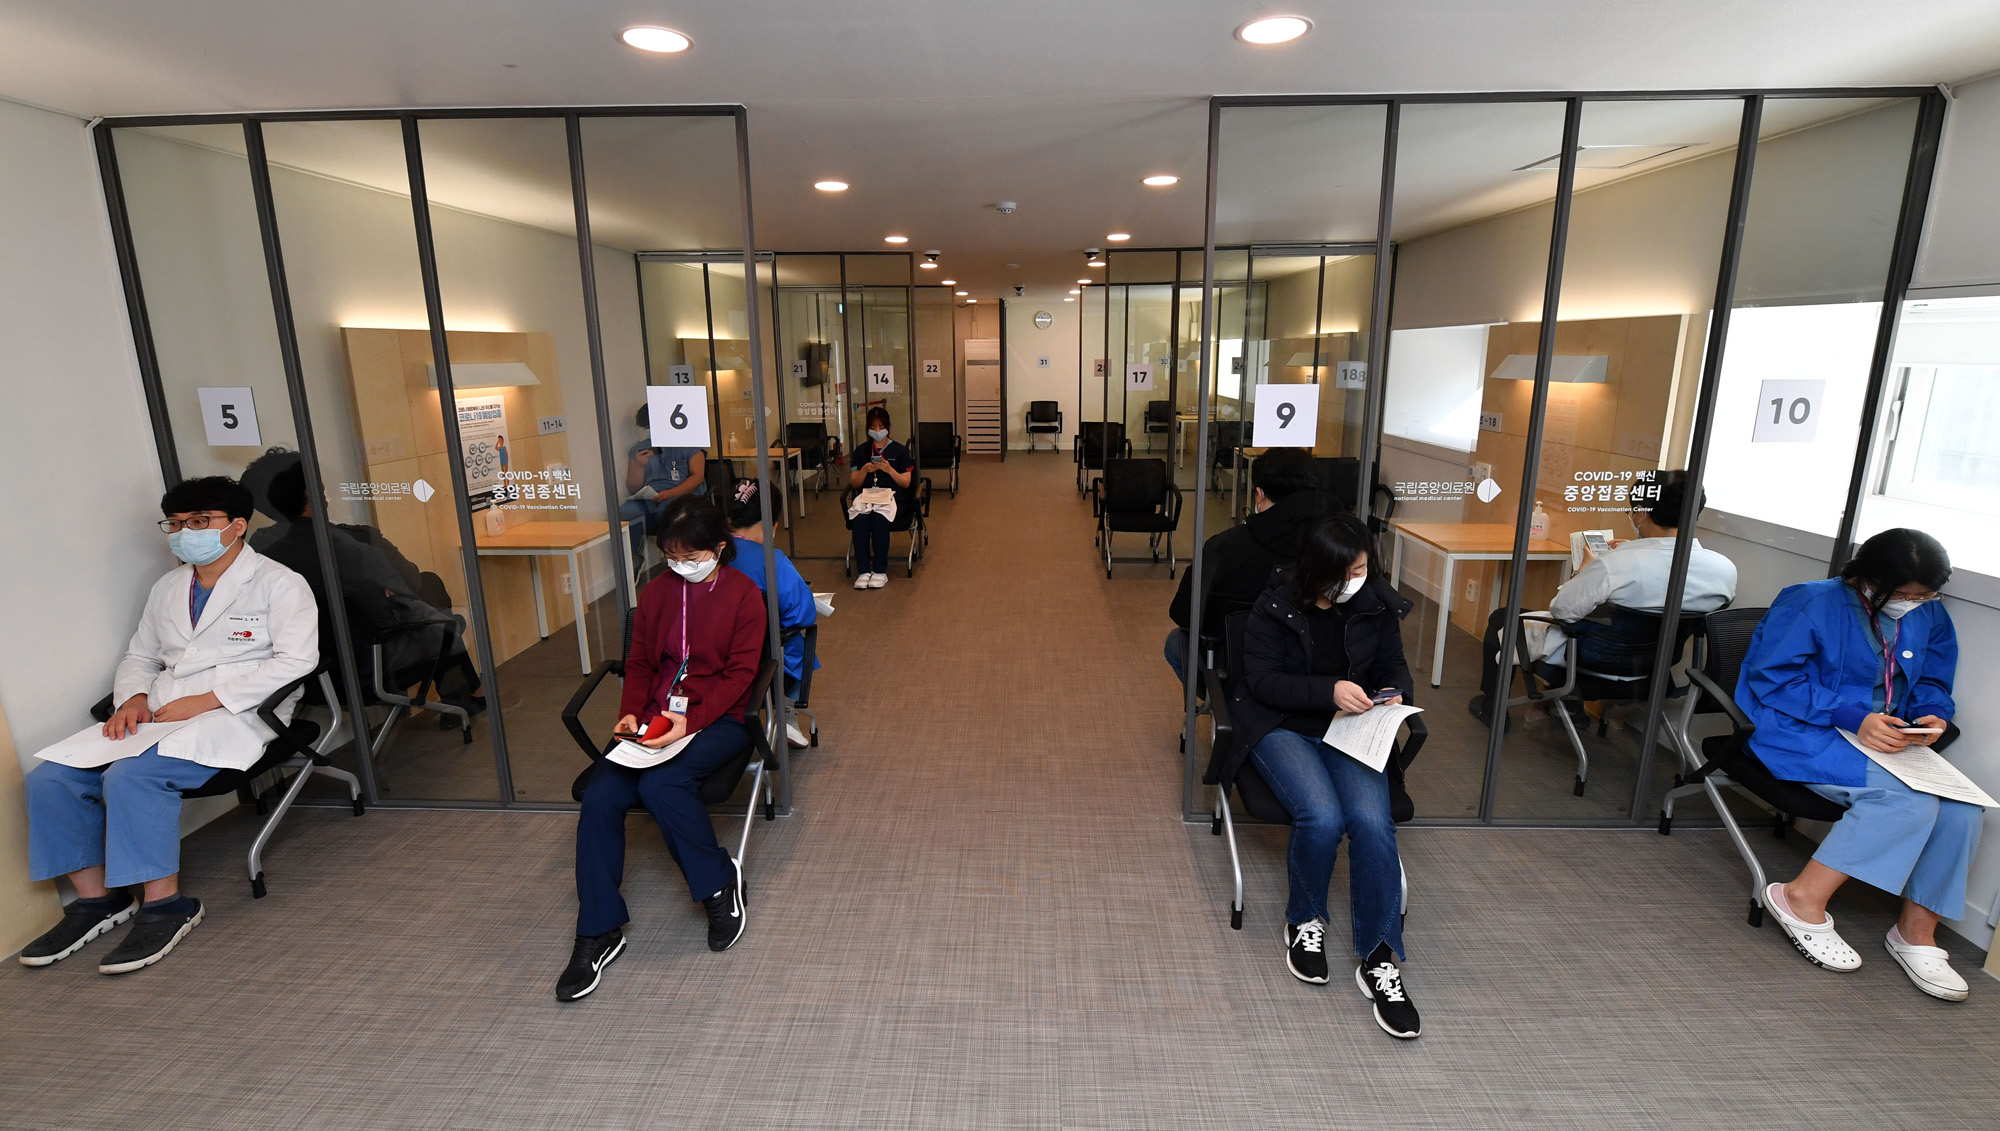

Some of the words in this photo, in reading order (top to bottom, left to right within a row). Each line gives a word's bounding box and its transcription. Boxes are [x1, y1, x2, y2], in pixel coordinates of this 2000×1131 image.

[793, 365, 803, 373] 21
[926, 365, 938, 373] 22
[675, 373, 690, 384] 13
[873, 373, 889, 385] 14
[1132, 371, 1148, 383] 17
[221, 404, 239, 430] 5
[669, 403, 688, 430] 6
[1276, 402, 1296, 429] 9
[1771, 397, 1811, 425] 10
[543, 418, 563, 430] 11-14
[497, 470, 550, 481] COVID-19
[552, 469, 572, 481] 백신
[1573, 470, 1633, 482] COVID-19
[1635, 470, 1656, 482] 백신
[339, 482, 411, 495] 국립중앙의료원
[492, 483, 581, 500] 중앙접종센터
[1394, 481, 1476, 495] 국립중앙의료원
[1563, 484, 1662, 502] 중앙접종센터
